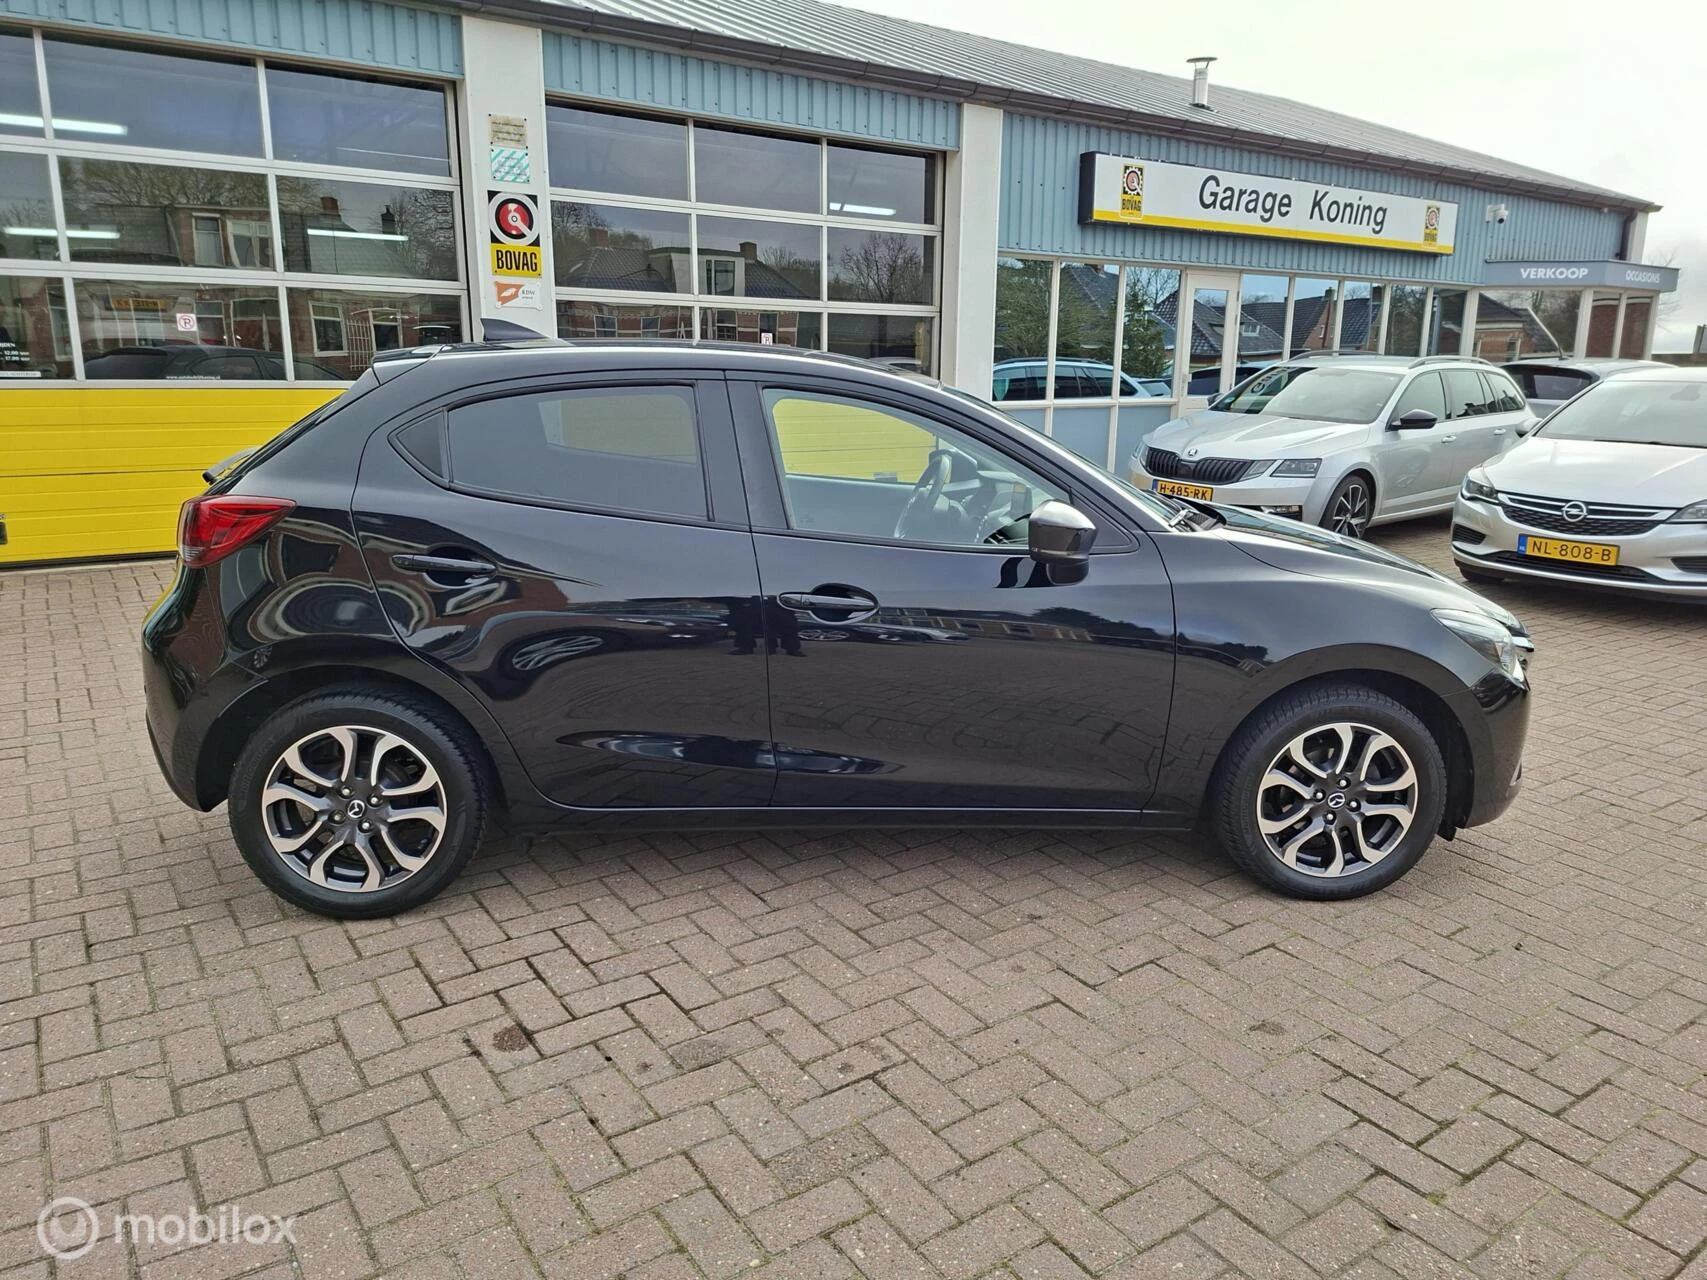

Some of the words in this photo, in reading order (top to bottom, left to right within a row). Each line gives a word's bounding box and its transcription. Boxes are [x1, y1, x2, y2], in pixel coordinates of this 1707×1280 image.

[1121, 198, 1142, 212] BOVAG
[1199, 174, 1292, 223] Garage
[1309, 190, 1388, 235] Koning
[495, 249, 538, 273] BOVAG
[1520, 267, 1589, 280] VERKOOP
[1625, 269, 1661, 284] OCCASIONS
[1159, 483, 1208, 501] H-485-RK
[1532, 540, 1612, 562] NL-808-B
